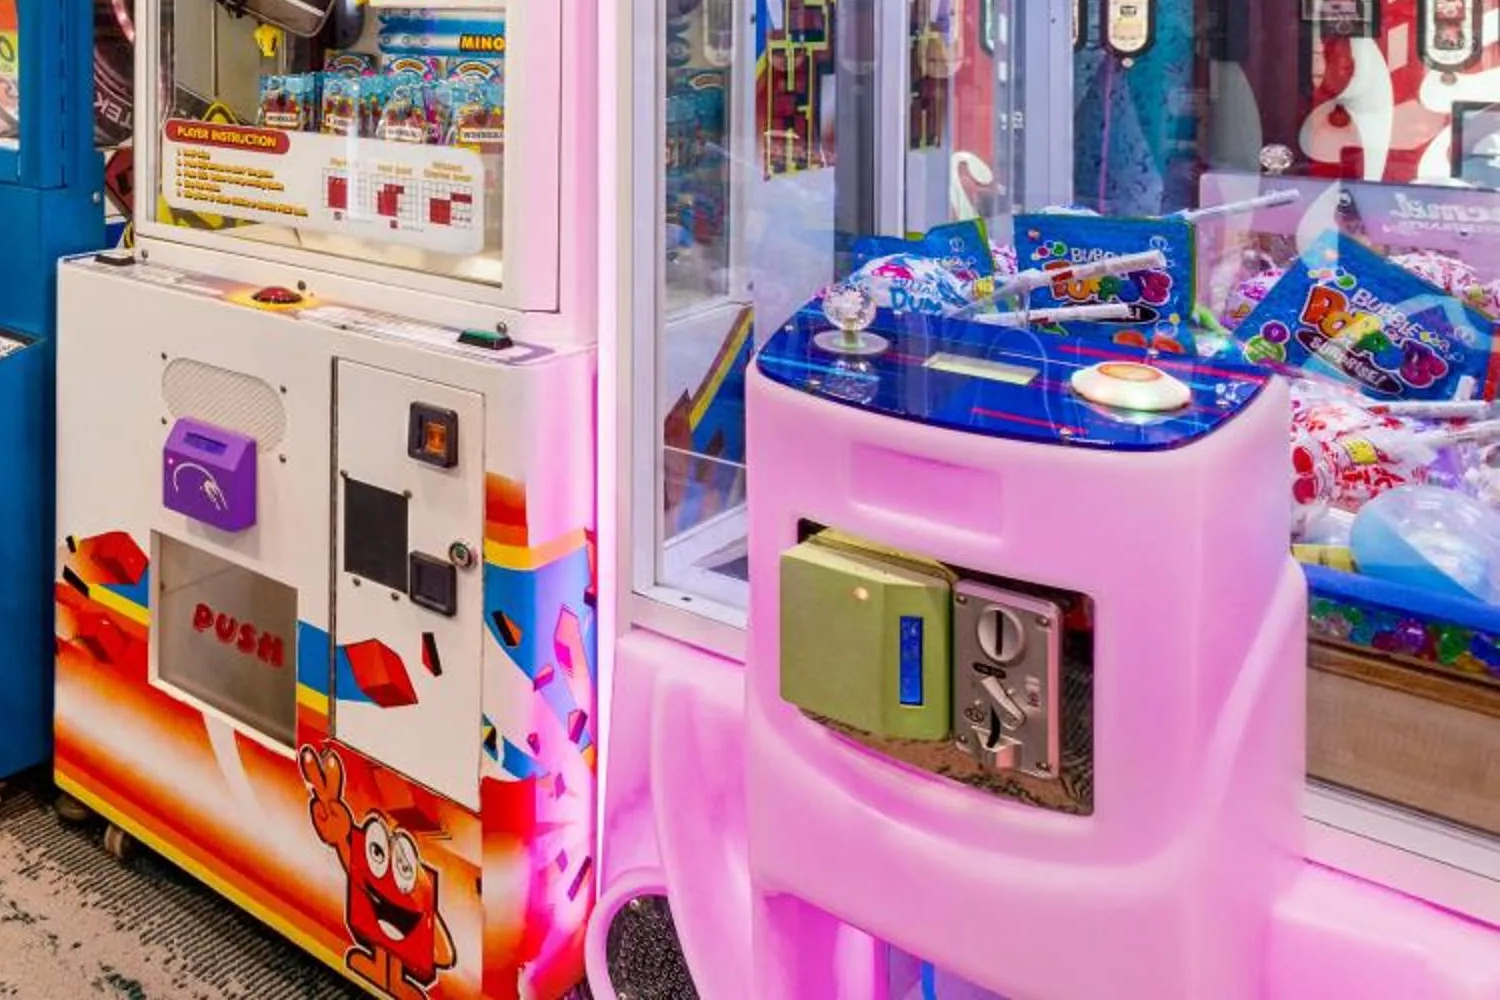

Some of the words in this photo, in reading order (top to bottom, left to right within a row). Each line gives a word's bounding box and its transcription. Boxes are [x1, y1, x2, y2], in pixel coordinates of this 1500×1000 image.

[177, 125, 209, 139] PLAYER
[211, 130, 277, 148] INSTRUCTION
[193, 603, 285, 669] PUSH
